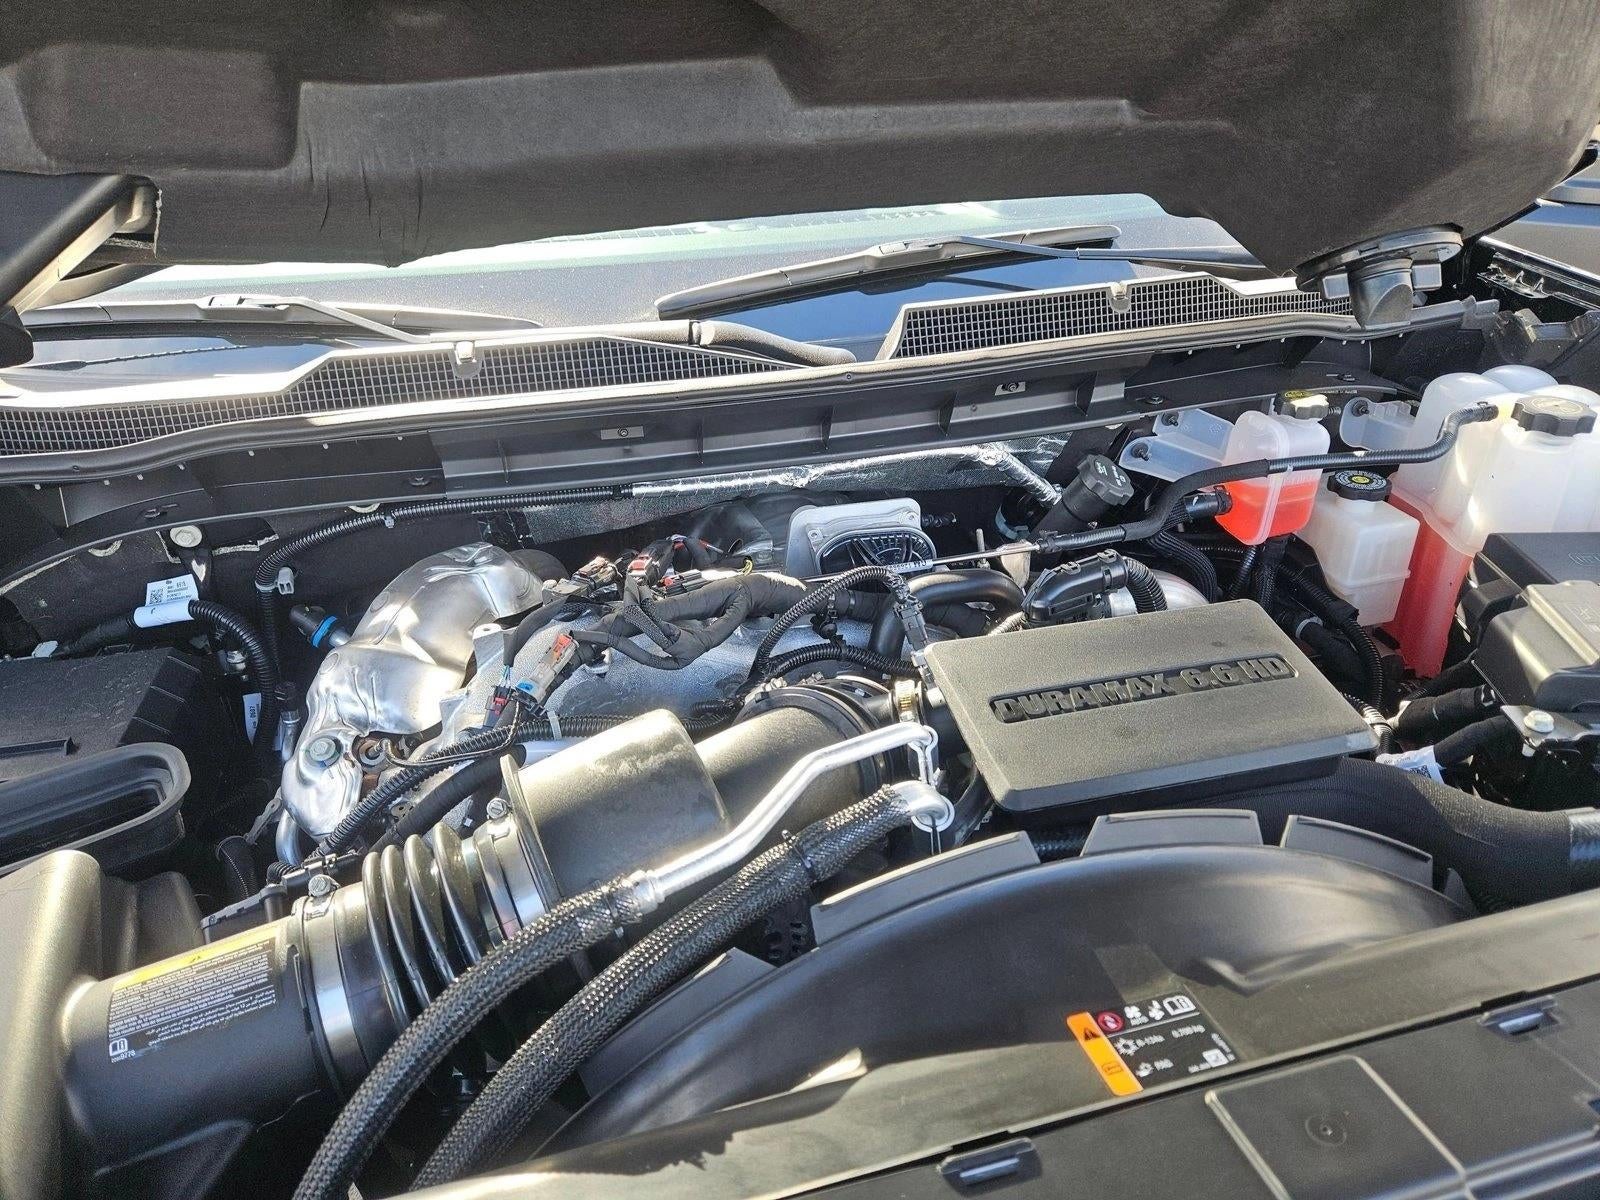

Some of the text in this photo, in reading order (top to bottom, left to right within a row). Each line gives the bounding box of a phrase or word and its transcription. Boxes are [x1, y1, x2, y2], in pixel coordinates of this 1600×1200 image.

[995, 656, 1290, 722] DURAMAX 6.6 HD
